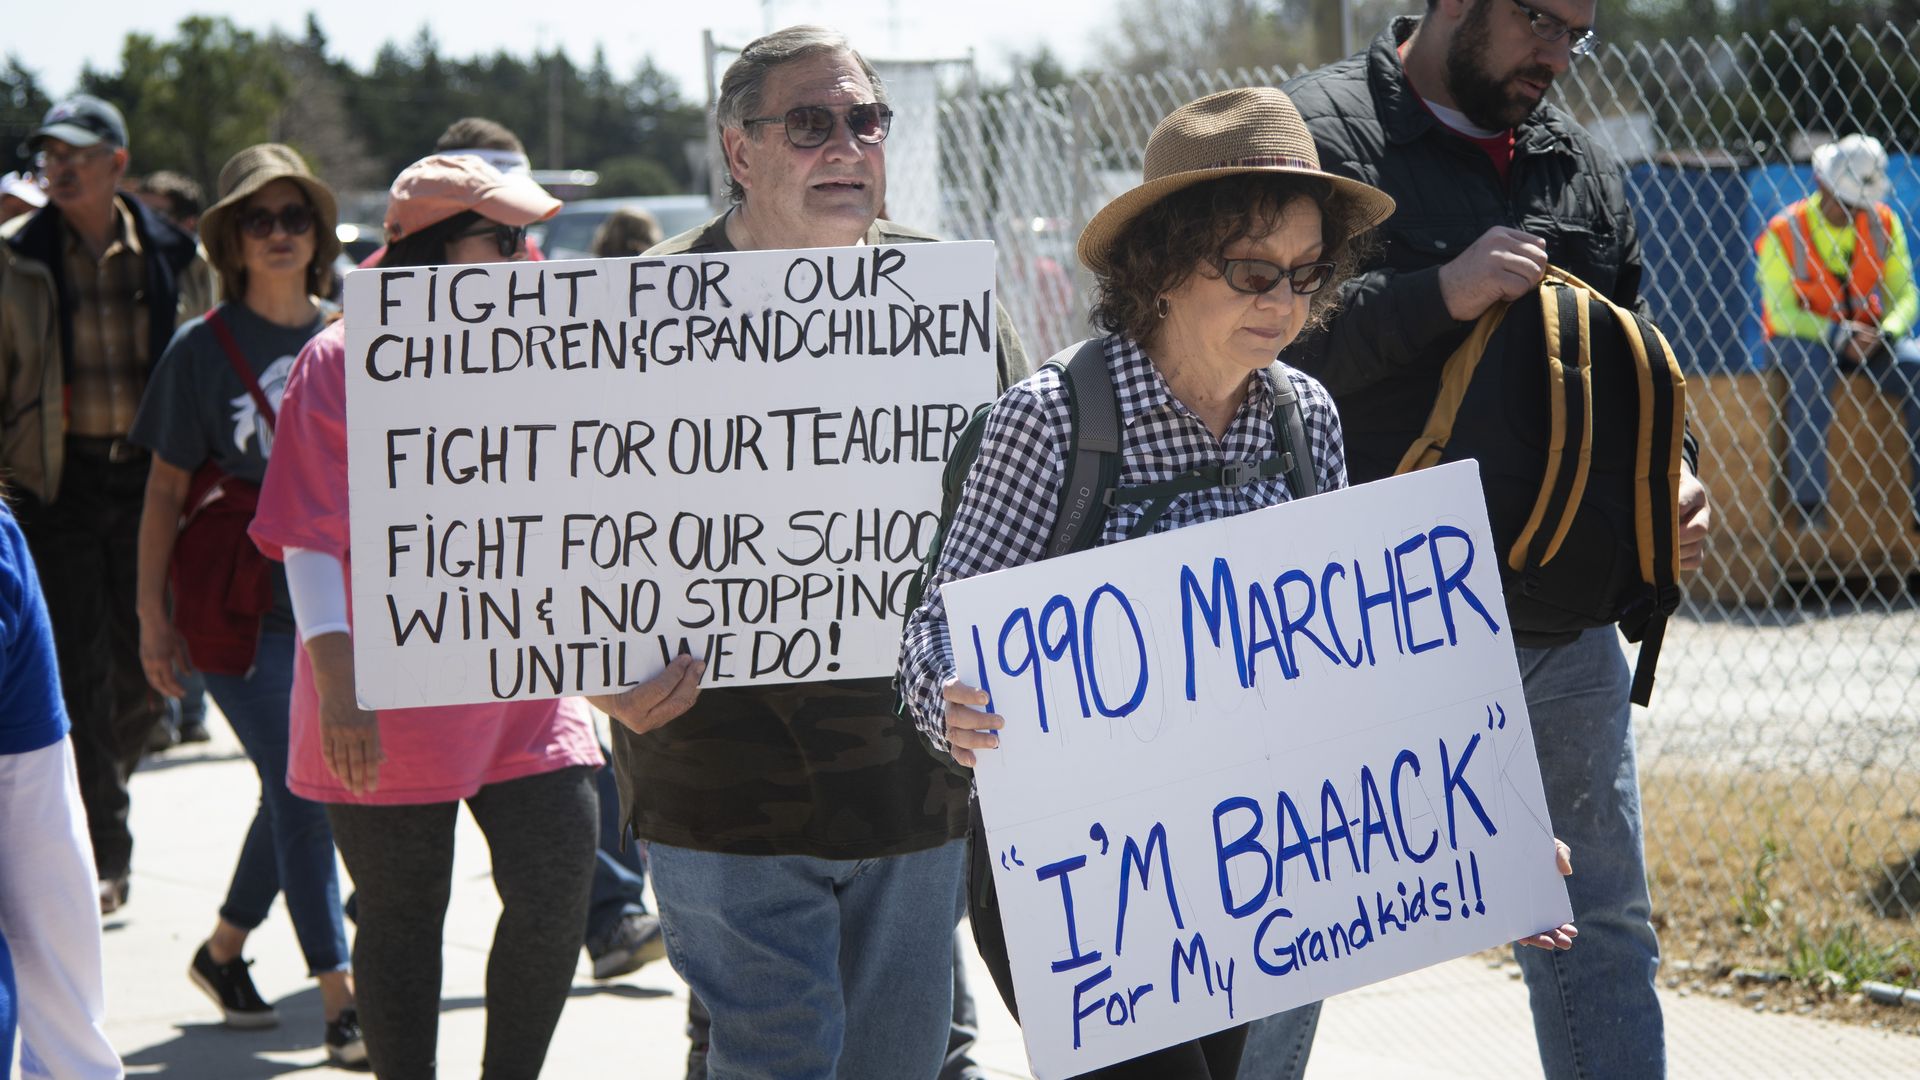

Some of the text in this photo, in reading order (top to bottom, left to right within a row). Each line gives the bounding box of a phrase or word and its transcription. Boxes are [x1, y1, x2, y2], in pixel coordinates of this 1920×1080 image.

[629, 260, 732, 318] FOR
[784, 247, 915, 304] OUR
[570, 418, 657, 478] FOR
[668, 414, 769, 475] OUR
[767, 402, 993, 471] TEACHER
[561, 511, 658, 570] FOR
[669, 511, 767, 573] OUR
[777, 508, 942, 567] SCHOO
[536, 587, 555, 636] &
[581, 578, 661, 635] NO
[971, 525, 1500, 749] 1990 MARCHER
[749, 621, 842, 680] DO!
[1073, 965, 1154, 1050] For
[1171, 931, 1235, 1020] My
